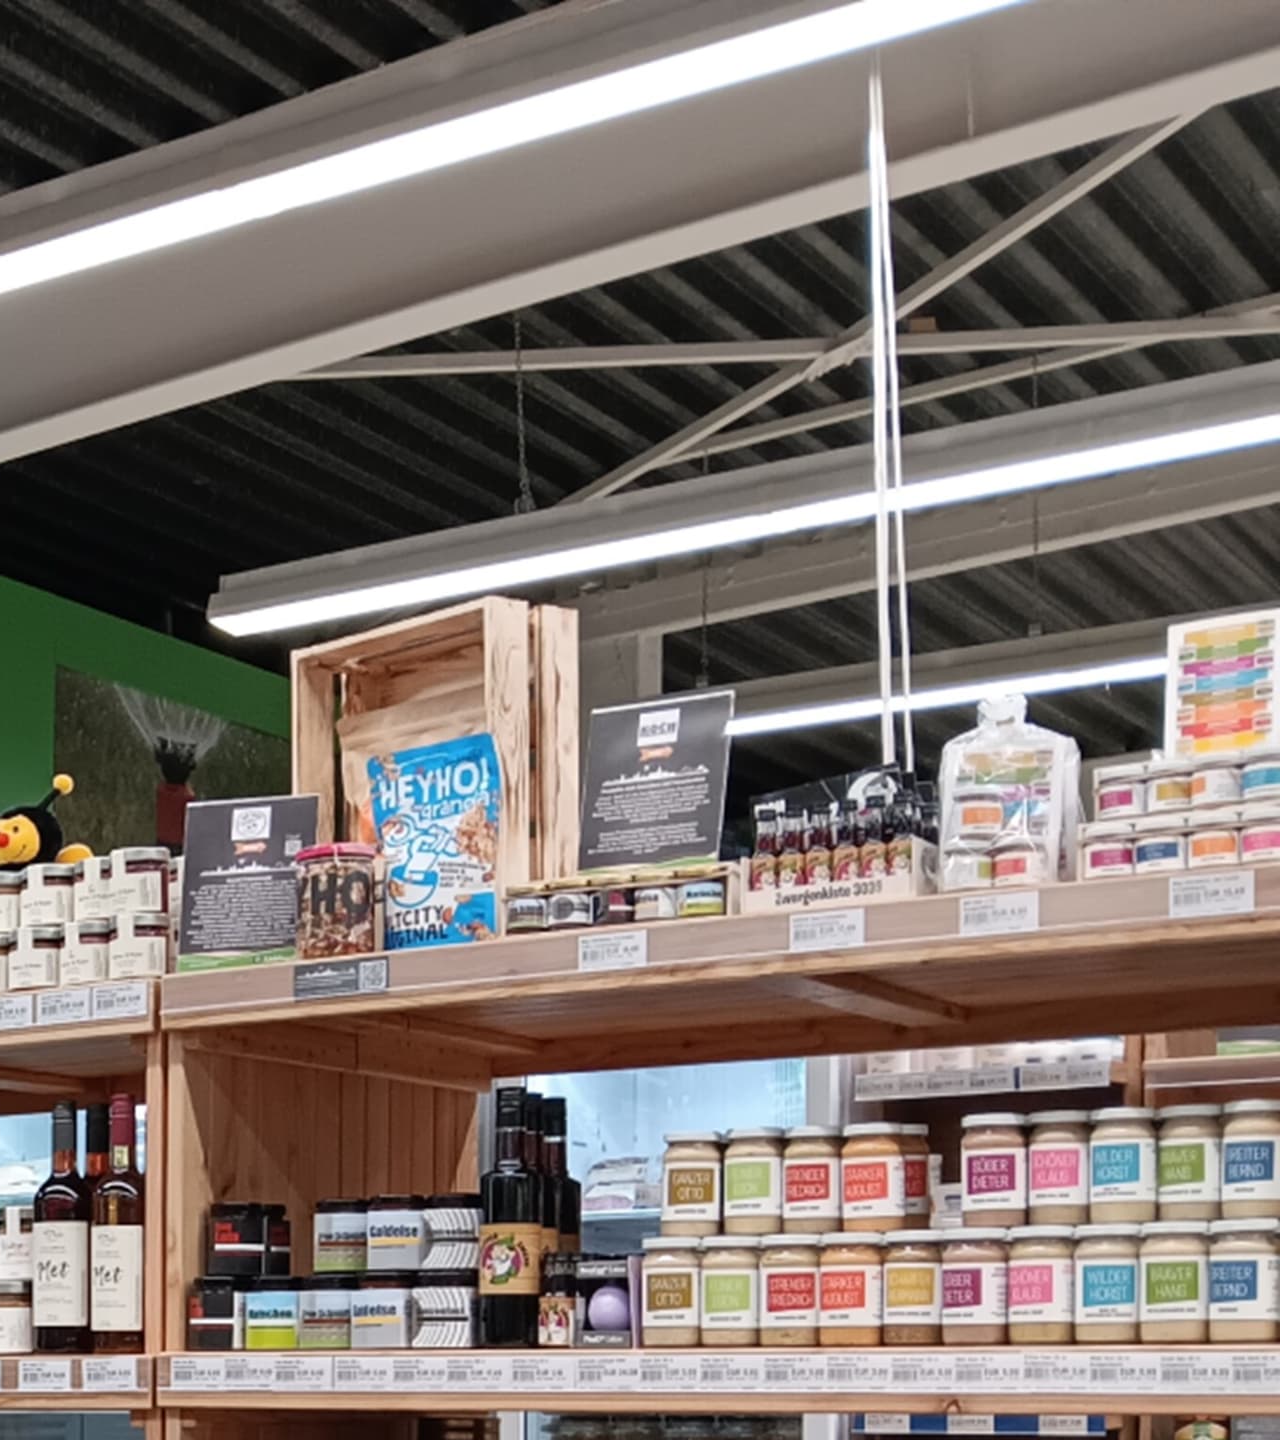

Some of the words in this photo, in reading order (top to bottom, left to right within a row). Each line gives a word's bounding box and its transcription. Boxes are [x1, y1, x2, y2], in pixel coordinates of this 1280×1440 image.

[378, 757, 490, 810] HEYHO!
[37, 1260, 70, 1279] Met
[93, 1265, 124, 1285] Met
